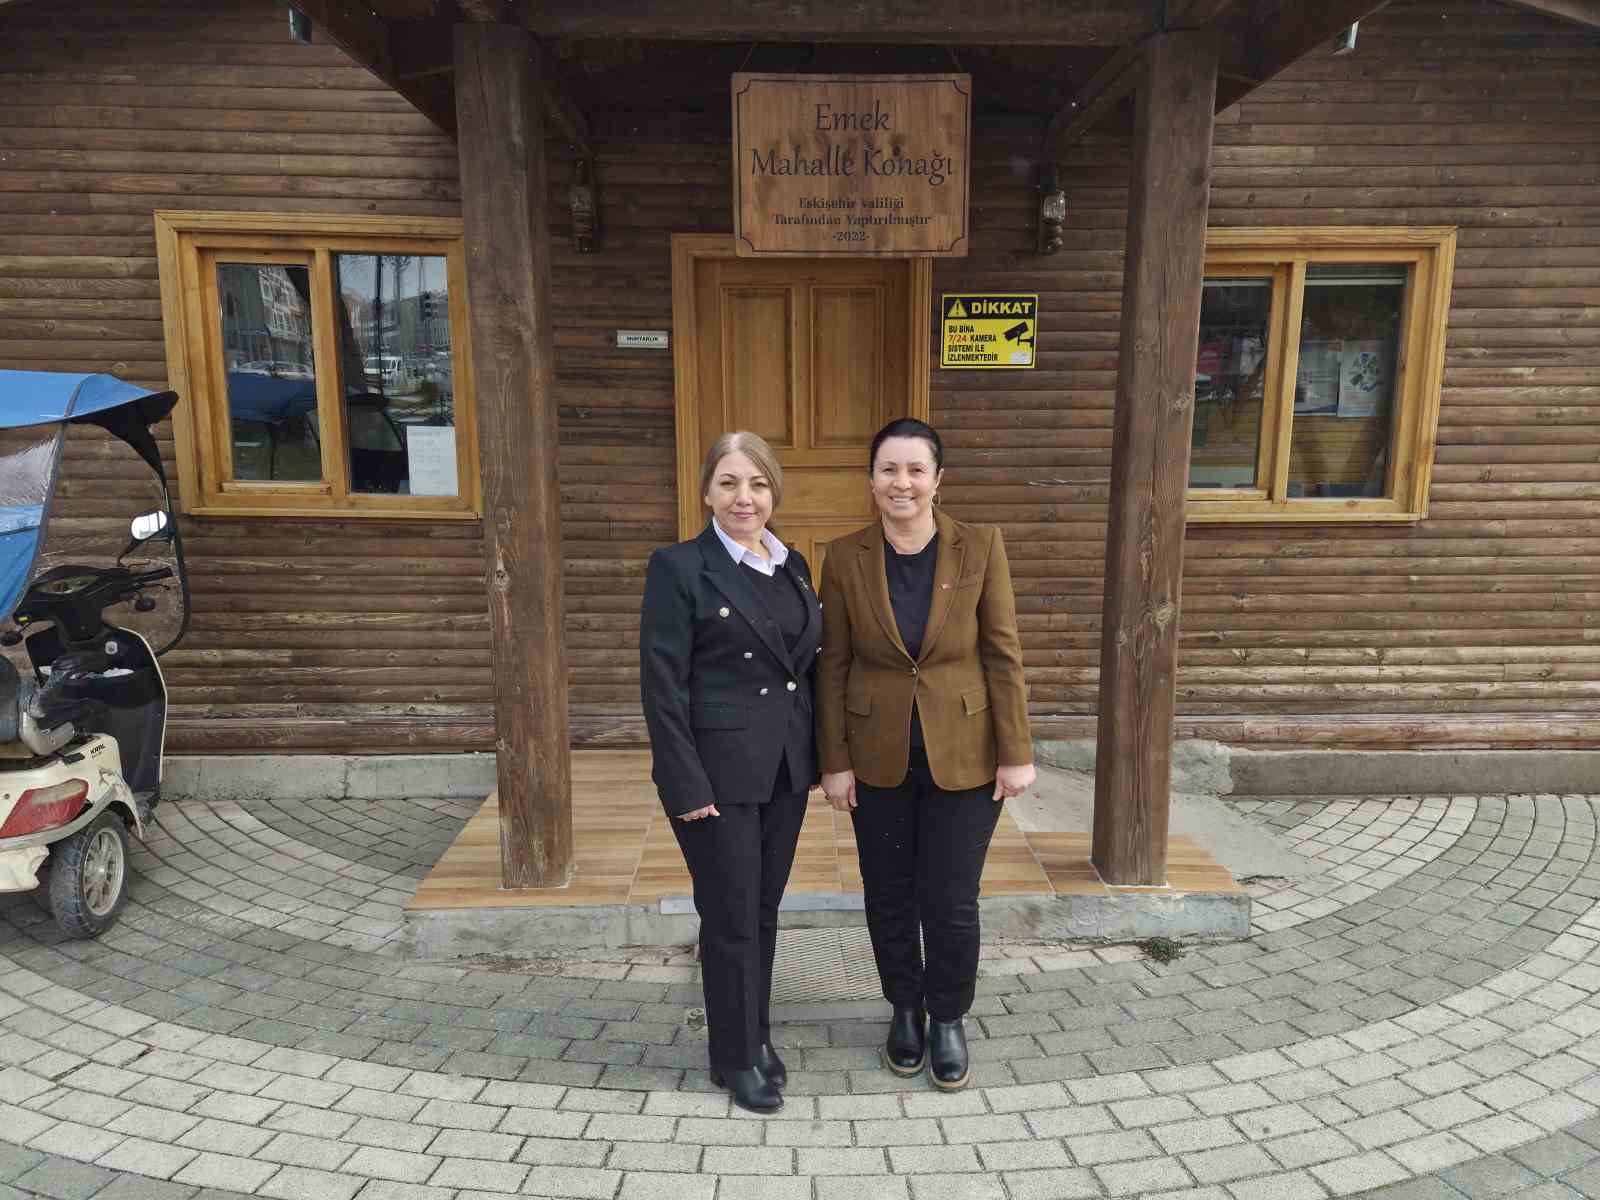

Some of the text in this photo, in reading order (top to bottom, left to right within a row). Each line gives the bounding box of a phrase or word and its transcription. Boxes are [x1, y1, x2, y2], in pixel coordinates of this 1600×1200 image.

[815, 100, 890, 131] Emek
[751, 145, 952, 186] Mahalle Konağı
[971, 299, 1032, 314] DİKKAT
[949, 335, 967, 343] 7/24
